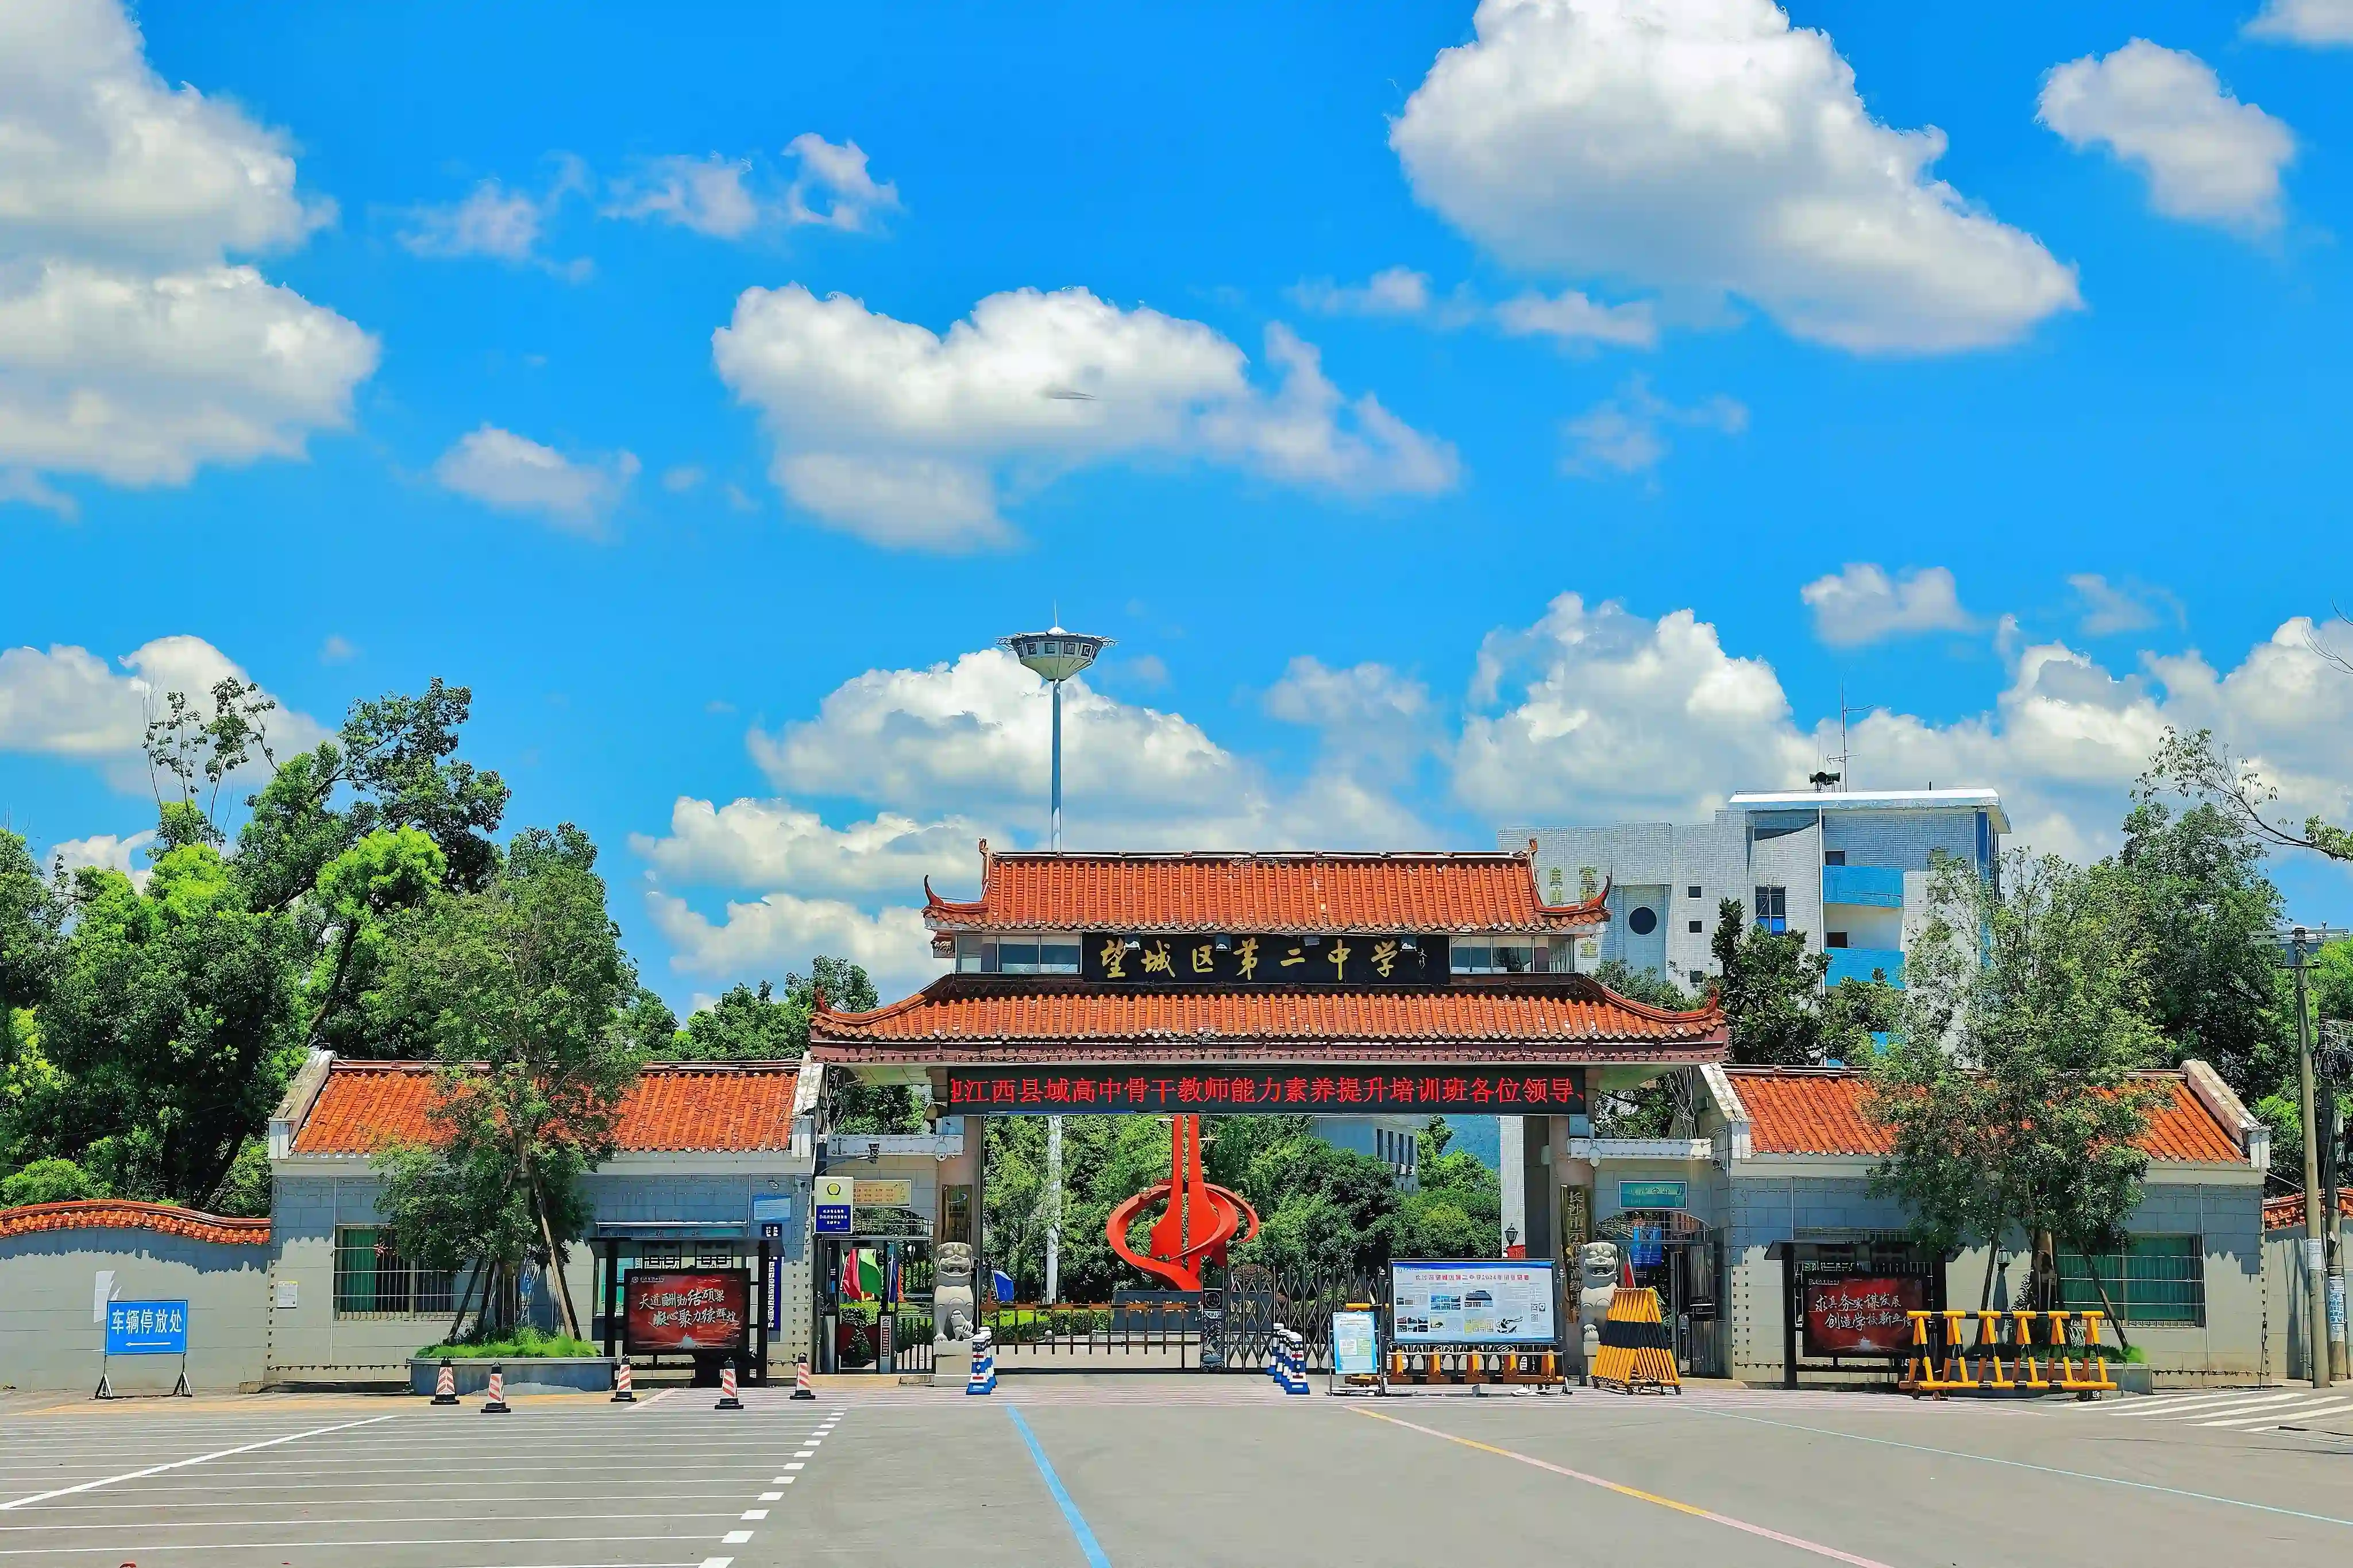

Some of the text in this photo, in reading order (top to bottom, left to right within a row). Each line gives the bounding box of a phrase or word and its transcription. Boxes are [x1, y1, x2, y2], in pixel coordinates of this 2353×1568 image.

[1101, 937, 1398, 980] 望城区第二中学
[111, 1308, 183, 1335] 车辆停放处
